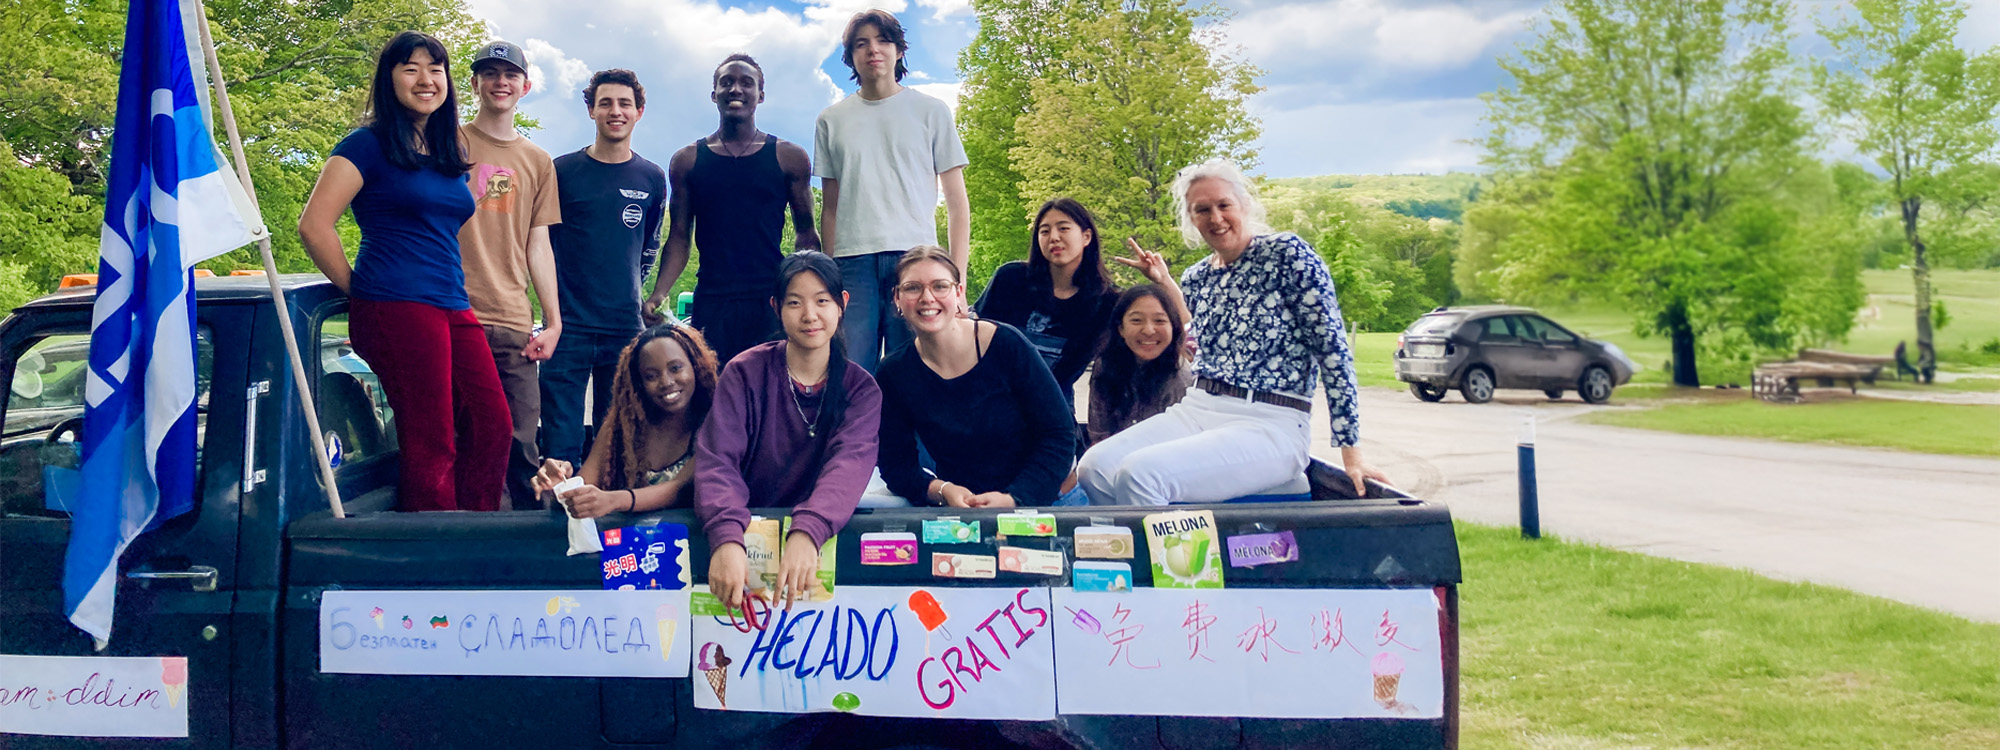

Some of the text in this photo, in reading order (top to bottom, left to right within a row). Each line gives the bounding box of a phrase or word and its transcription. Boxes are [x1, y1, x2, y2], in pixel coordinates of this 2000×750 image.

[1152, 515, 1209, 537] MELONA
[746, 549, 773, 560] kfruit
[1233, 545, 1275, 559] MELONA
[603, 553, 638, 579] 光明
[330, 606, 650, 655] Безплатен СЛАДОЛЕД
[738, 588, 1048, 710] HELADO GRATIS
[60, 672, 161, 709] ddim
